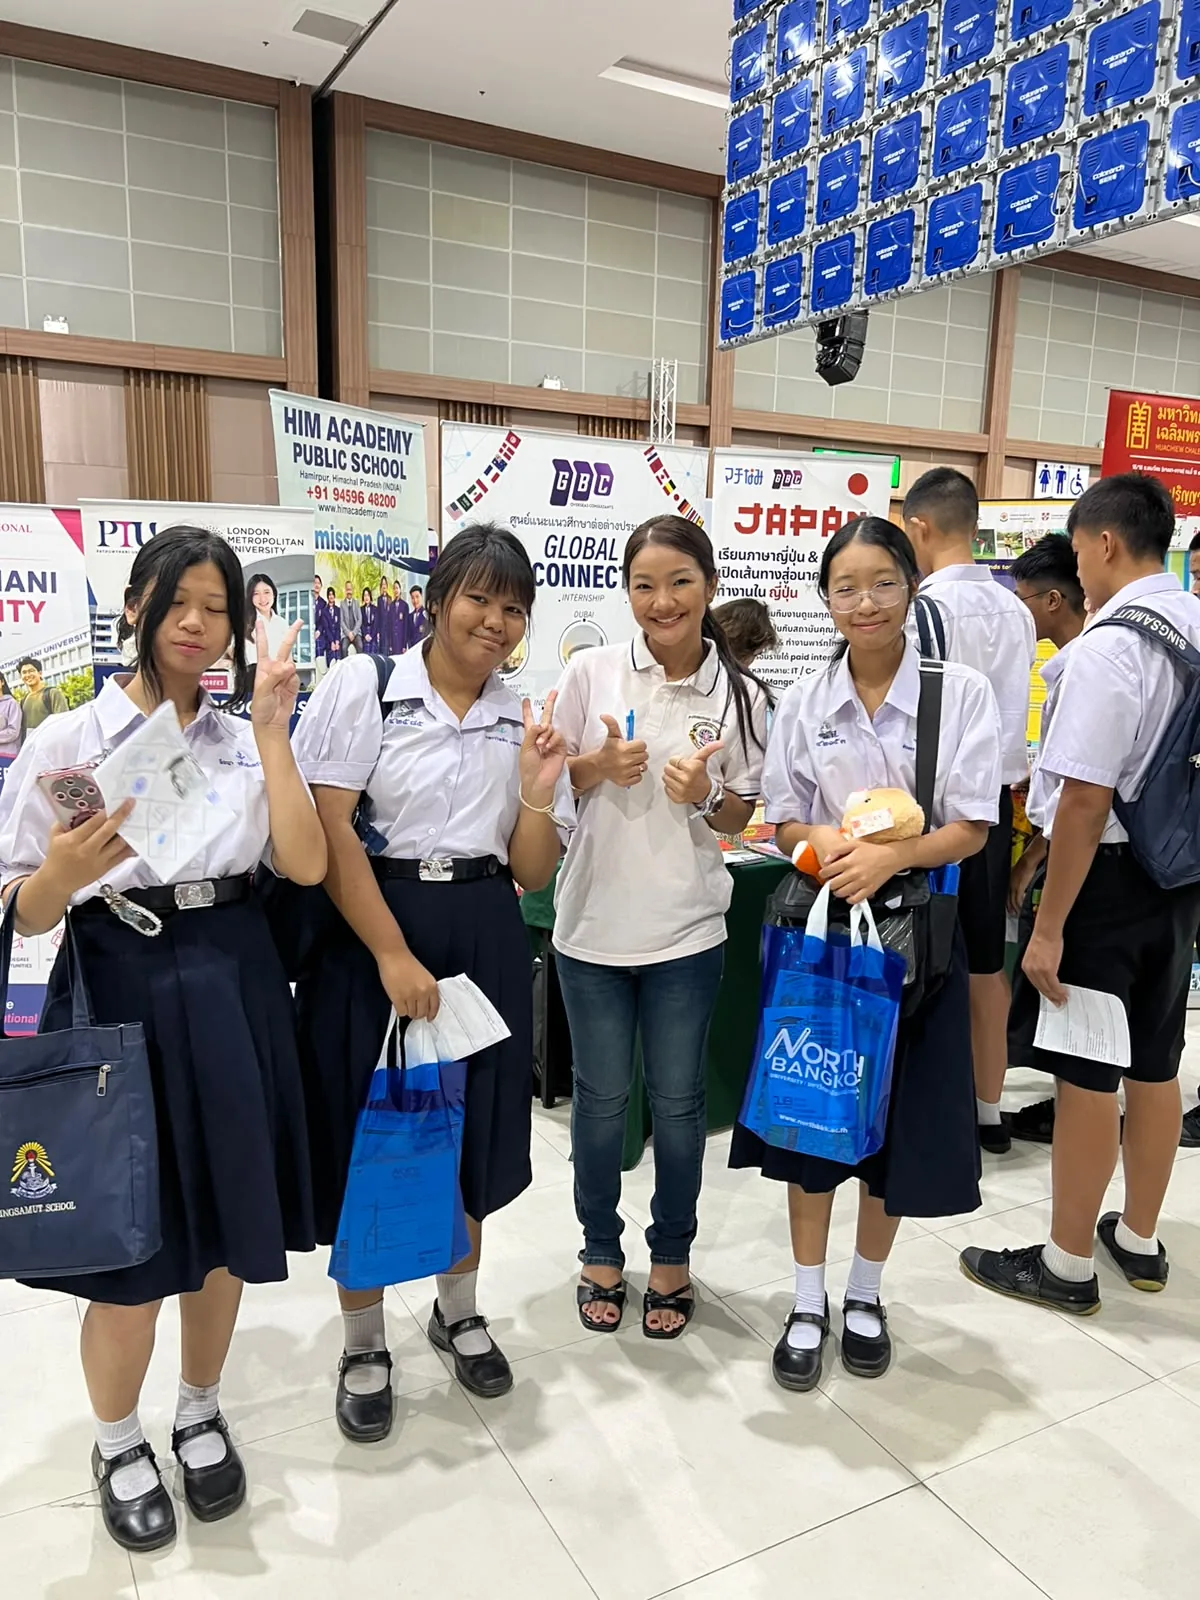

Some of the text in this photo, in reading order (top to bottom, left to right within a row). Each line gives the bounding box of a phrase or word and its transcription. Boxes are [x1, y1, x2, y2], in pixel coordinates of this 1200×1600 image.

[284, 406, 413, 456] HIM ACADEMY
[293, 442, 407, 480] PUBLIC SCHOOL
[300, 470, 332, 483] Hamirpur,
[332, 476, 358, 486] Himachal
[360, 479, 382, 489] Pradesh
[725, 467, 763, 485] マチなみ
[306, 485, 396, 509] +91 94596 48200
[318, 503, 388, 519] www.himacademy.com
[734, 503, 869, 537] JAPA
[0, 523, 32, 533] ONAL
[97, 520, 157, 548] PTU
[227, 527, 270, 536] LONDON
[227, 536, 304, 546] METROPOLITAN
[376, 529, 409, 561] Open
[544, 534, 618, 561] GLOBAL
[718, 545, 818, 566] เรียนภาษาญี่ปุ่น &
[562, 593, 605, 602] INTERNSHIP
[717, 581, 798, 602] ทำงานใน ญี่ปุ่น
[573, 610, 595, 618] DUBAI
[1113, 608, 1187, 650] SINGSAMUT
[790, 653, 809, 662] paid
[764, 1027, 865, 1078] NORTH
[771, 1057, 861, 1088] BANGKO
[45, 1200, 76, 1212] SCHOOL
